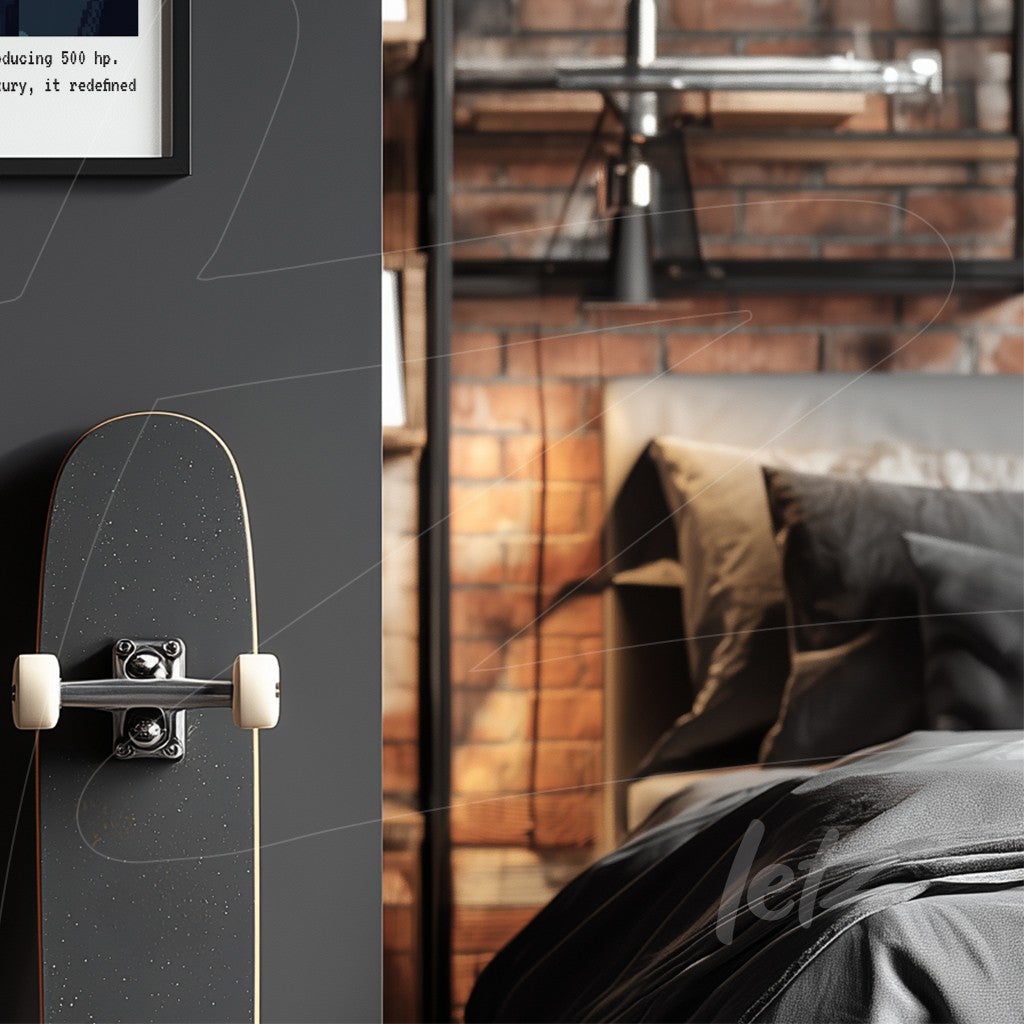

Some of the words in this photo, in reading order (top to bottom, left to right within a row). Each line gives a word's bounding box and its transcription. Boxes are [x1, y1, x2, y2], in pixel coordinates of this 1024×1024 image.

[61, 50, 86, 65] 500
[94, 50, 118, 68] hp.
[44, 78, 60, 92] it
[69, 78, 137, 92] redefined
